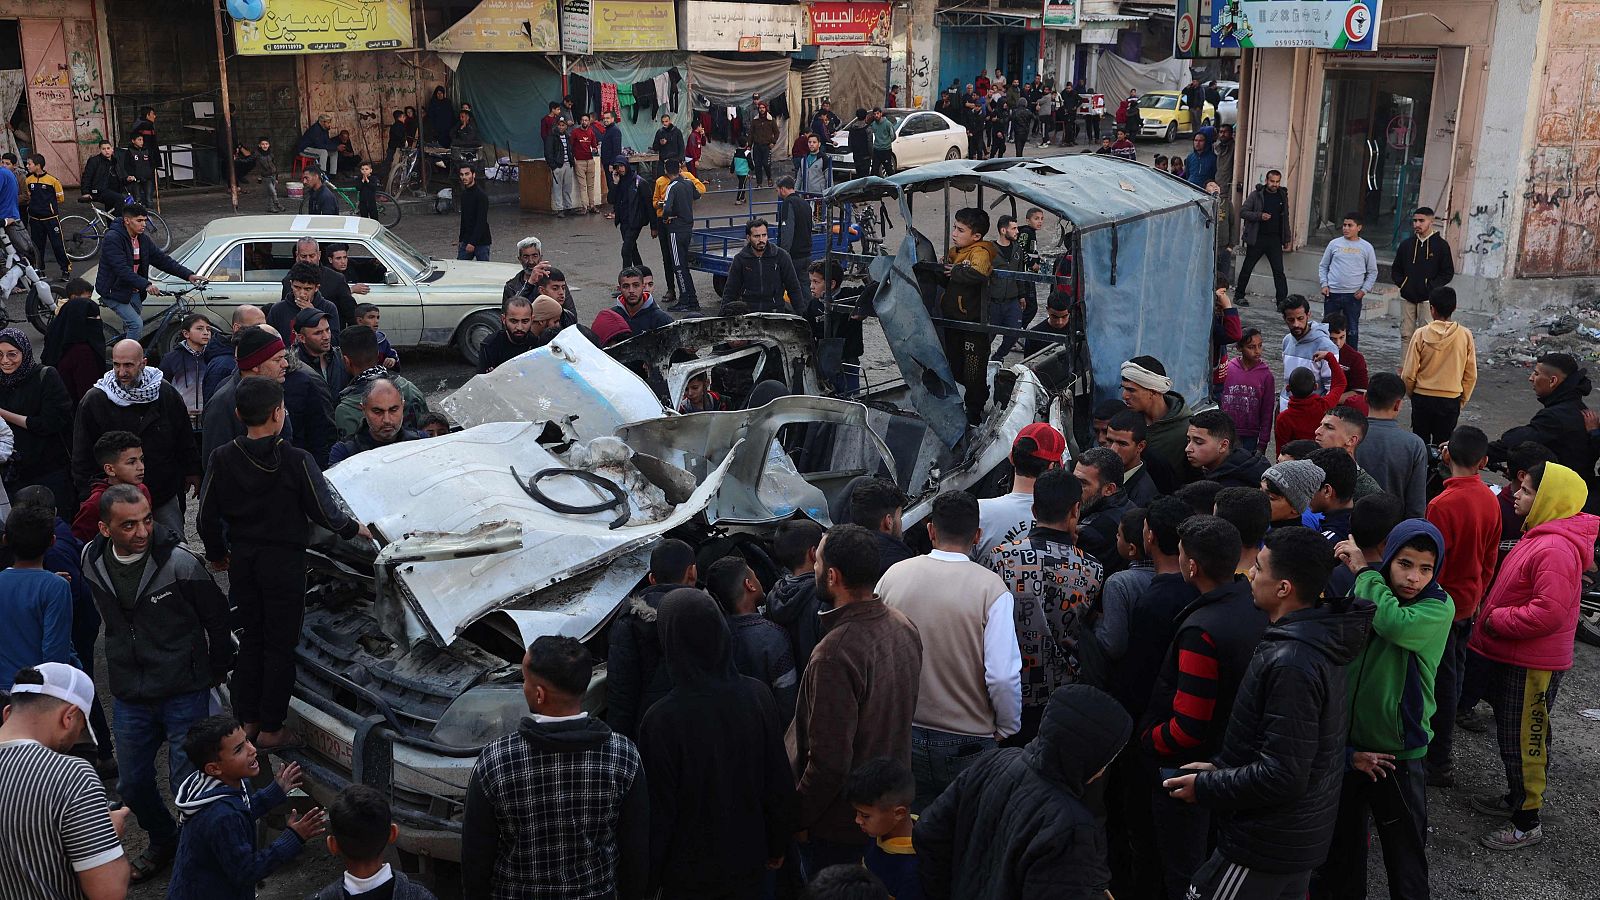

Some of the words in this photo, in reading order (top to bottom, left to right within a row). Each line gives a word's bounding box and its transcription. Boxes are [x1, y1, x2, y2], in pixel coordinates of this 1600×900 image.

[263, 5, 378, 42] الياسين
[814, 8, 854, 28] الحبيبي
[964, 341, 975, 352] BR
[1528, 709, 1545, 757] SPORTS
